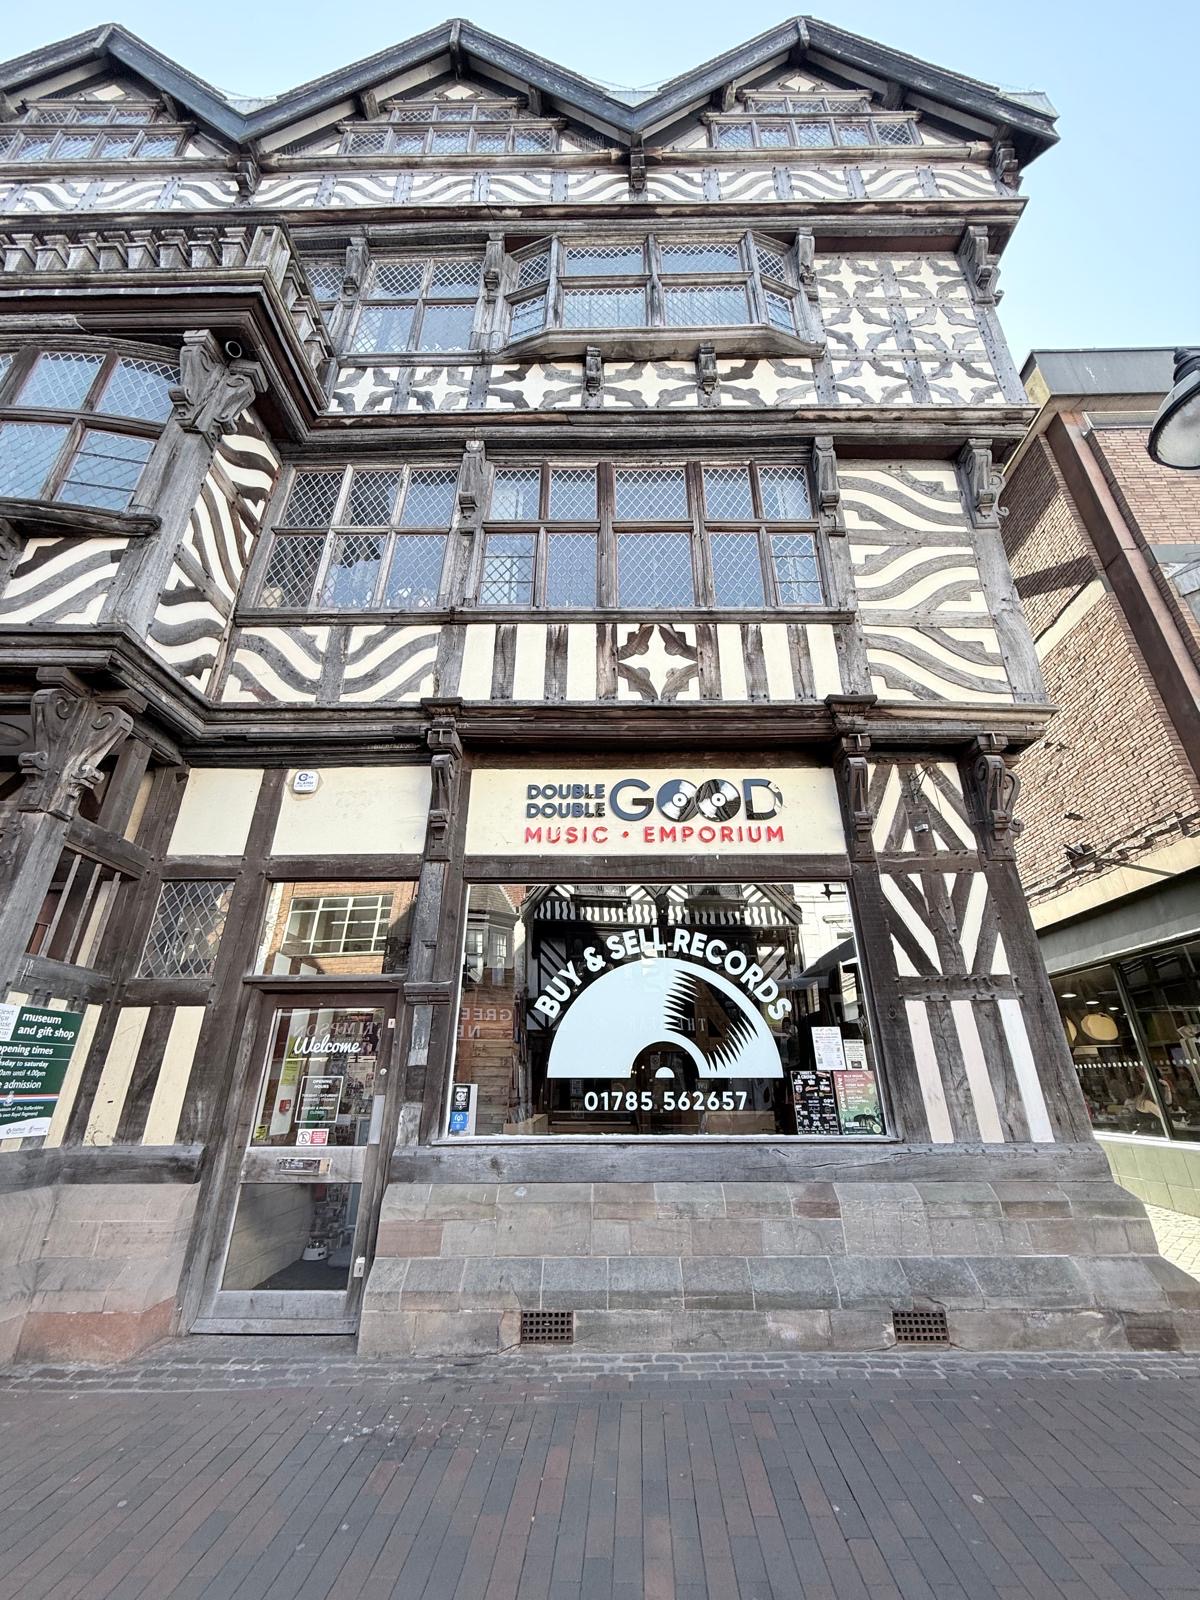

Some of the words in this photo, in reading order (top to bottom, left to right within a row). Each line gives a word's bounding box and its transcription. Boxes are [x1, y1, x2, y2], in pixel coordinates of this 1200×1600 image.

[526, 784, 605, 800] DOUBLE
[609, 778, 784, 823] GOOD
[526, 802, 605, 818] DOUBLE
[524, 825, 609, 844] MUSIC
[643, 825, 785, 844] EMPORIUM
[533, 960, 583, 1019] BUY
[583, 946, 607, 973] &
[606, 927, 667, 960] SELL
[673, 928, 792, 1020] RECORDS
[22, 1013, 62, 1025] museum
[17, 1025, 37, 1035] and
[36, 1026, 54, 1039] gift
[54, 1028, 75, 1040] shop
[31, 1045, 54, 1055] times
[293, 1034, 361, 1055] Welcome
[0, 1059, 16, 1068] sday
[24, 1060, 49, 1069] saturday
[12, 1069, 27, 1077] until
[3, 1079, 42, 1089] admission
[584, 1091, 653, 1111] 01785
[663, 1091, 748, 1111] 562657
